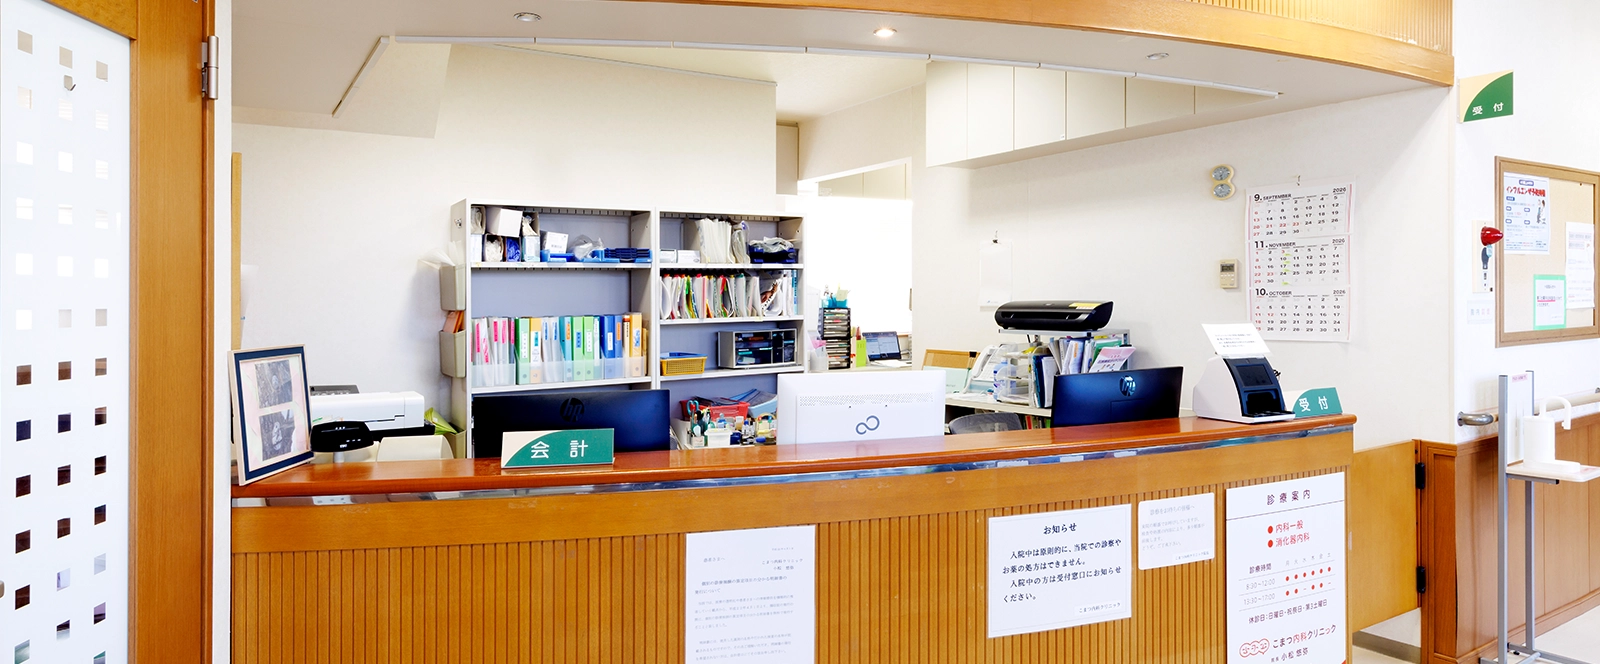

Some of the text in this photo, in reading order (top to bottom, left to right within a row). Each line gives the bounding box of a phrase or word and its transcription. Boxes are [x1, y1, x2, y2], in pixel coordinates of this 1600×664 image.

[1472, 102, 1504, 116] 受付
[1254, 194, 1262, 202] 9.
[1262, 193, 1292, 201] SEPTEMBER
[1298, 396, 1329, 413] 受付
[530, 439, 588, 459] 会計
[1267, 489, 1310, 506] 診療案内
[1042, 522, 1078, 536] お知らせ
[1276, 520, 1304, 534] 内科一般
[1276, 531, 1310, 547] 消化器内科
[1010, 538, 1122, 560] 入院中は原則的に、当院での診察や
[1002, 557, 1086, 575] お薬の処方はできません。
[1249, 563, 1272, 574] 診療時間
[1010, 566, 1122, 588] 入院中の方は受付窓口にお知らせ
[1002, 593, 1037, 603] ください。
[1078, 601, 1121, 613] こまつ内科クリニック
[1272, 624, 1336, 649] こまつ内科クリニック
[1281, 651, 1294, 661] 小松
